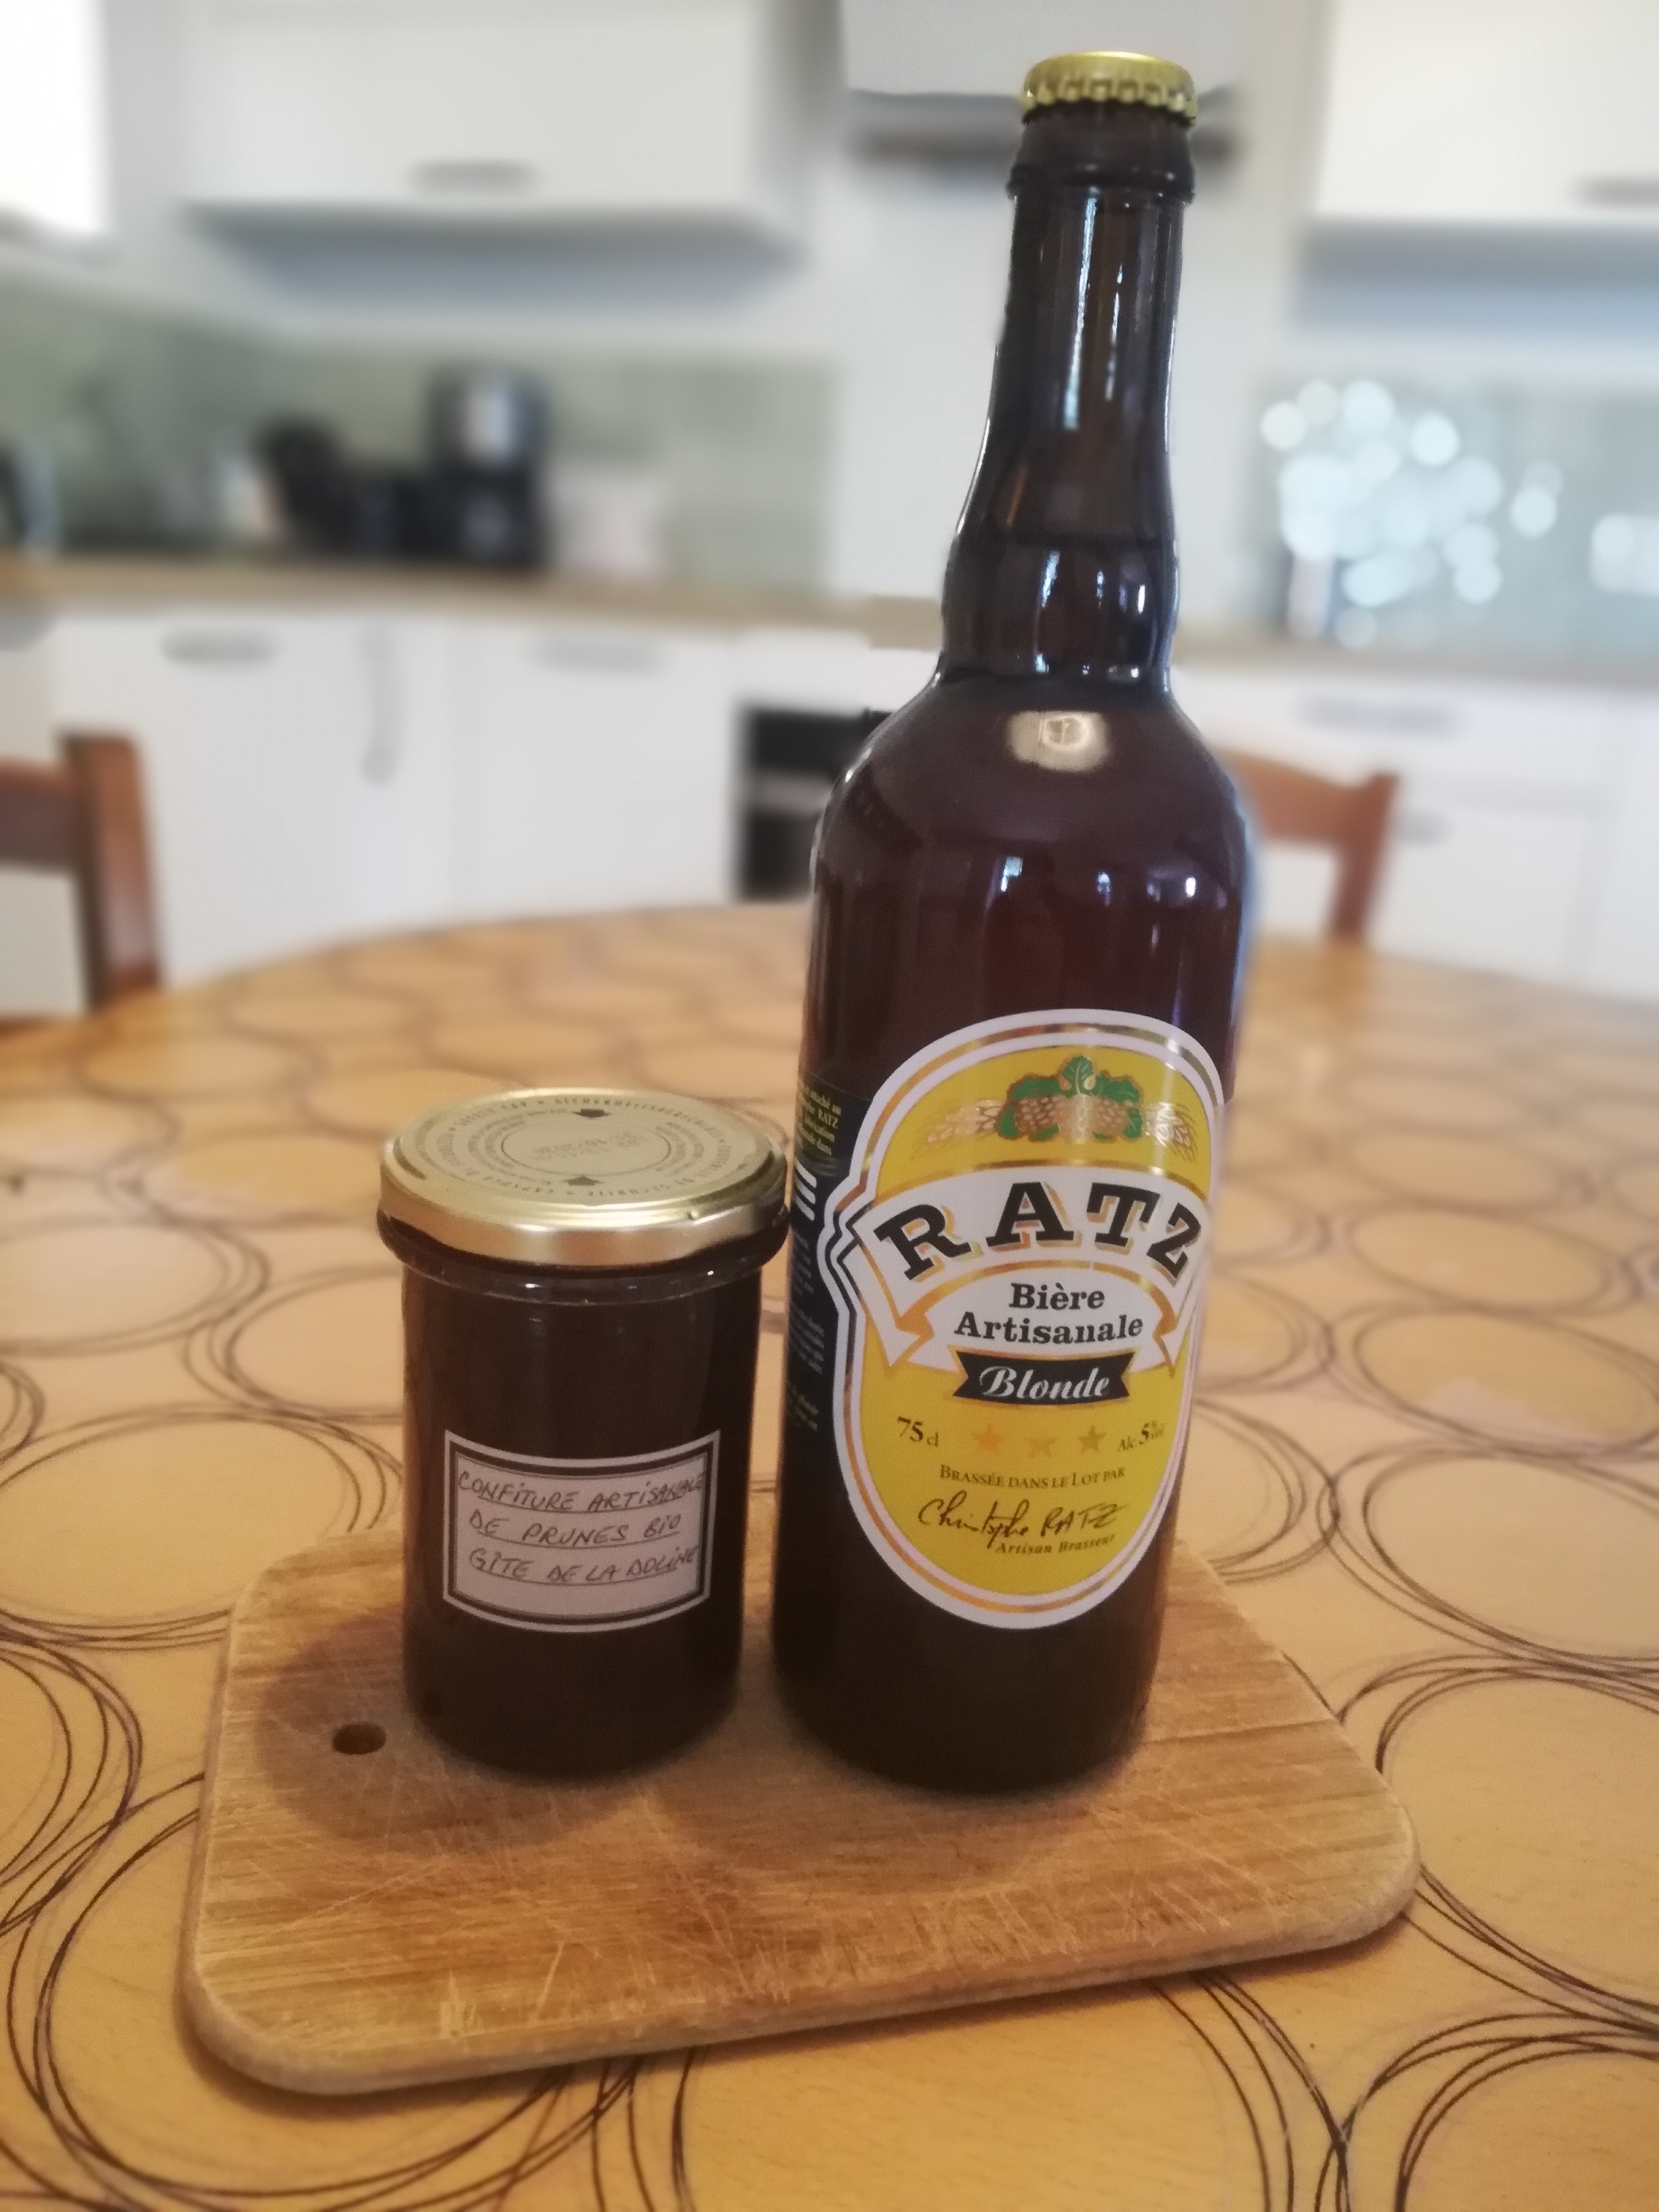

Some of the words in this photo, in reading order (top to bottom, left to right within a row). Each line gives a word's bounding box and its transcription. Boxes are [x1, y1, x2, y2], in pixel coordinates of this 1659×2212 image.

[818, 1108, 839, 1129] RATZ
[874, 1181, 1204, 1282] RATZ
[1008, 1282, 1105, 1311] Bière
[954, 1311, 1143, 1345] Artisanale
[979, 1365, 1111, 1400] Blonde
[468, 1509, 510, 1535] DE
[522, 1522, 630, 1547] PRUNES
[996, 1542, 1052, 1554] Artisan
[1058, 1534, 1115, 1553] Brasseur
[546, 1563, 583, 1582] DE
[585, 1563, 621, 1582] LA
